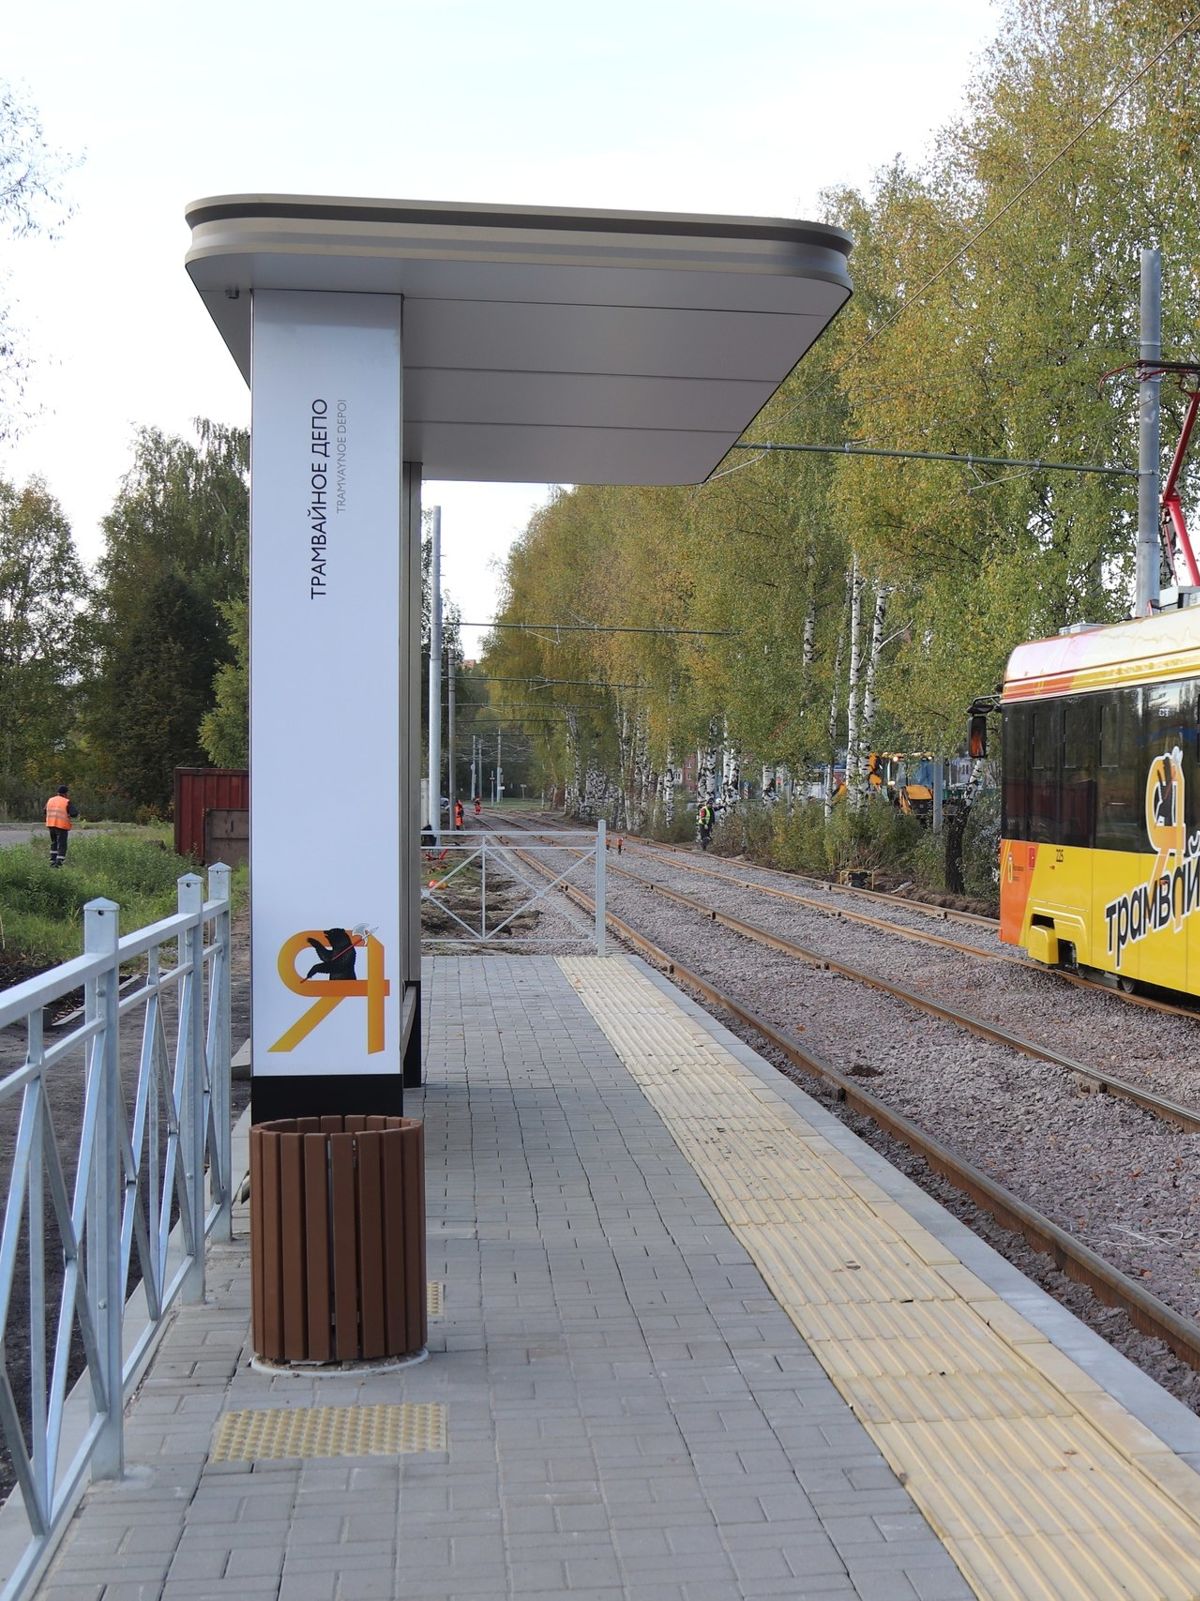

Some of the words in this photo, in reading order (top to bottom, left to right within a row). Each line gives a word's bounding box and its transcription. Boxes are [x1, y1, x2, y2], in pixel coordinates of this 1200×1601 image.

[311, 398, 331, 458] ДЕПО
[336, 436, 347, 514] TRAMVAYNOE
[307, 462, 328, 600] ТРАМВАЙНОЕ
